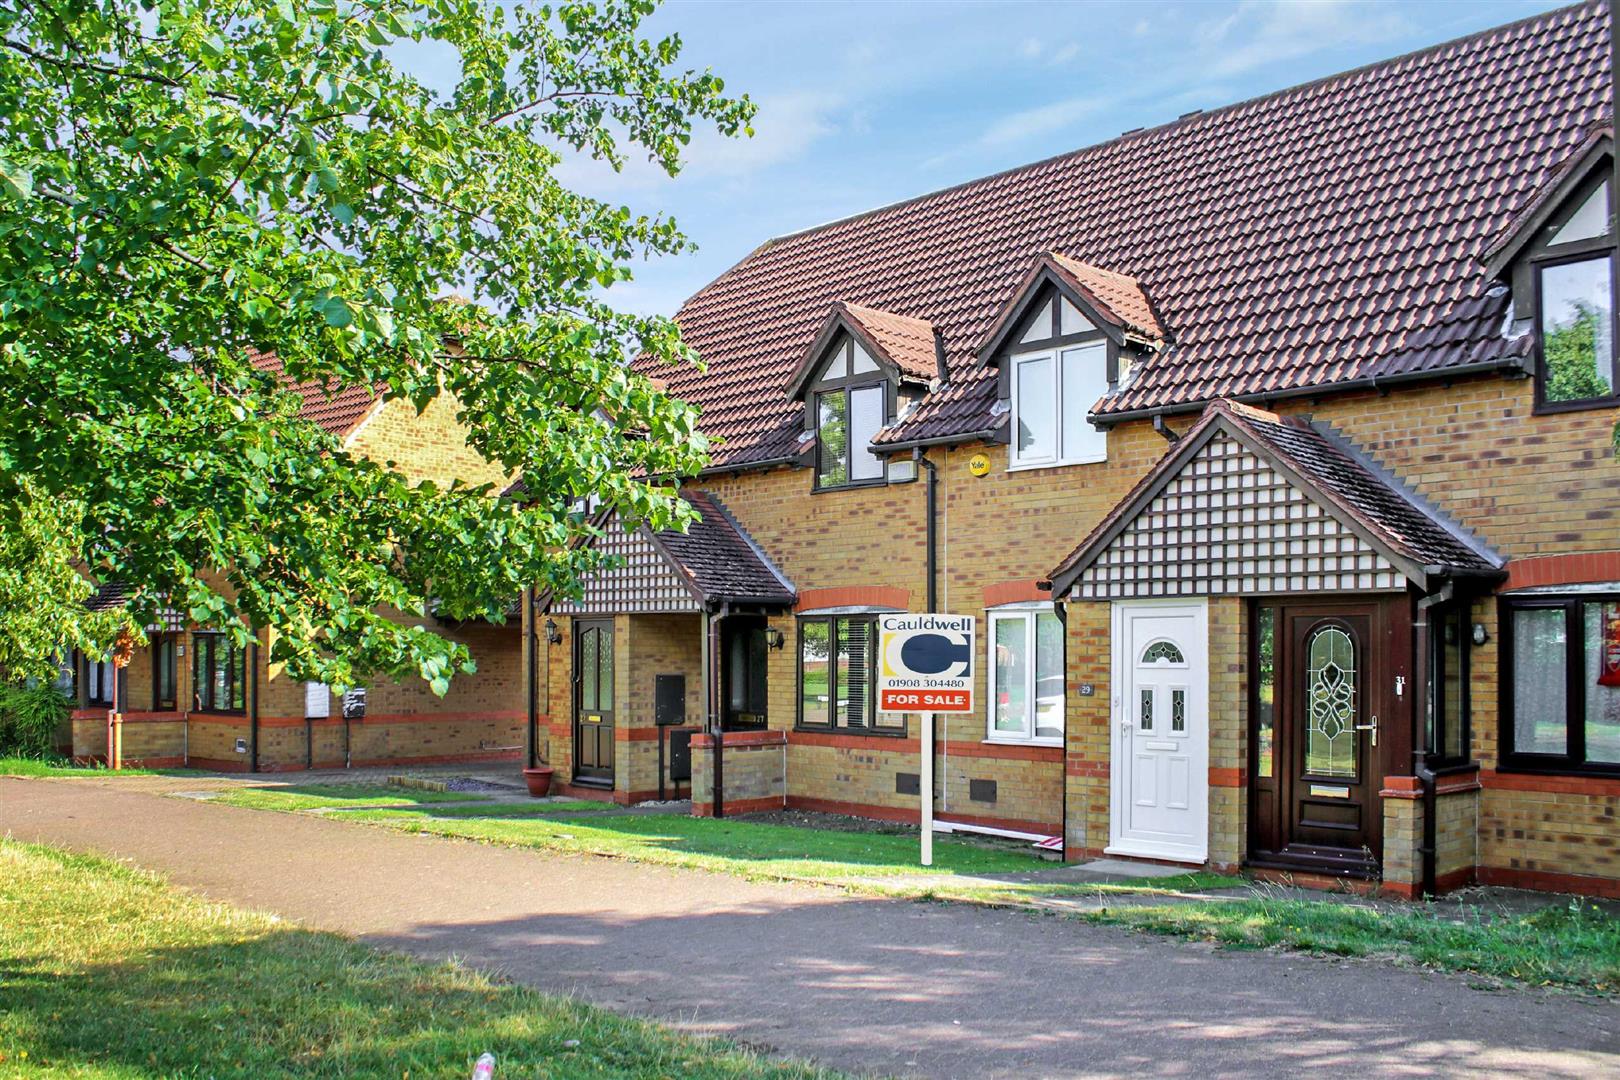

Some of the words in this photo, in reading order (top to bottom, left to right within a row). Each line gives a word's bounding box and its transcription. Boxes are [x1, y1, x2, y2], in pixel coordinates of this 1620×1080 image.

[971, 461, 985, 469] Yale
[883, 617, 971, 631] Cauldwell
[888, 679, 920, 688] 01908
[923, 680, 965, 688] 304480
[1395, 676, 1406, 685] 31
[1081, 685, 1091, 694] 29
[887, 694, 919, 704] FOR
[923, 695, 964, 705] SALE
